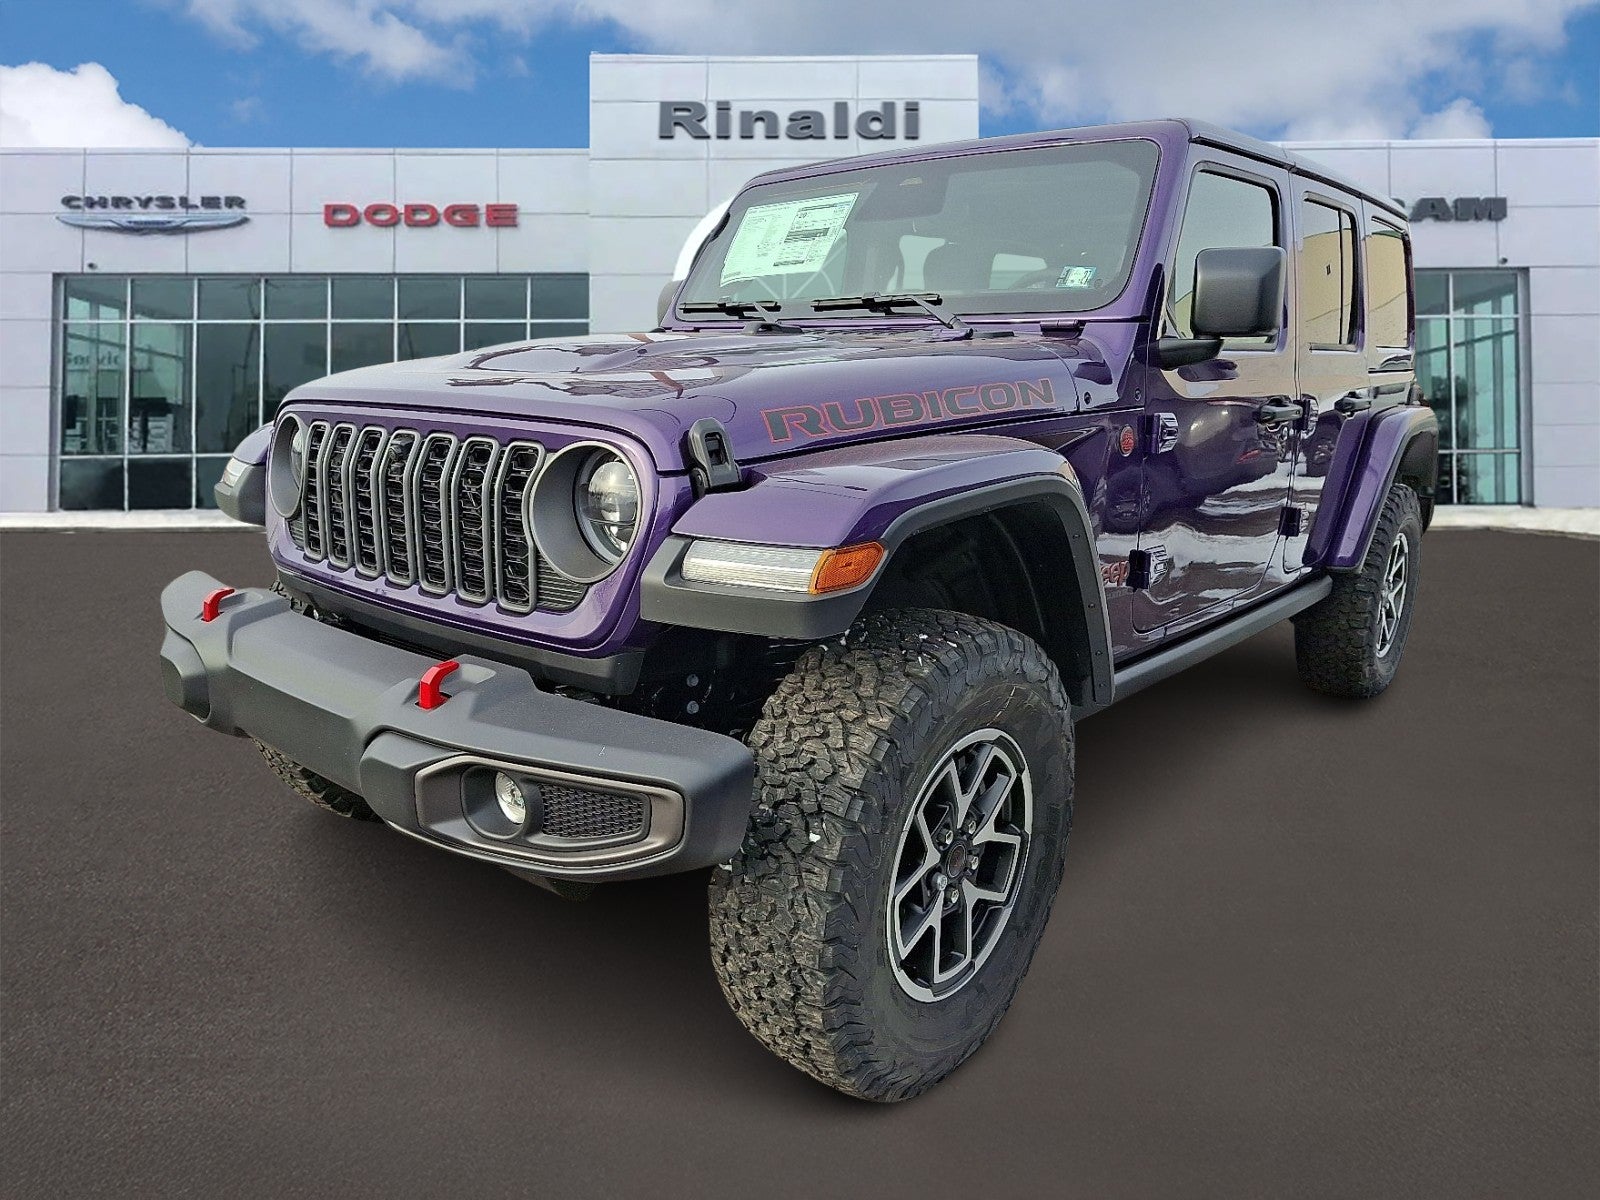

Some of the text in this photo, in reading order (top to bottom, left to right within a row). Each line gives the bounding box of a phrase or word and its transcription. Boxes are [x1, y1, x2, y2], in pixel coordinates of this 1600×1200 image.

[659, 101, 919, 139] Rinaldi
[60, 195, 246, 209] CHRYSLER
[1392, 197, 1507, 222] AM
[324, 204, 518, 228] DODGE
[761, 378, 1056, 442] RUBICON
[1101, 561, 1129, 586] eep
